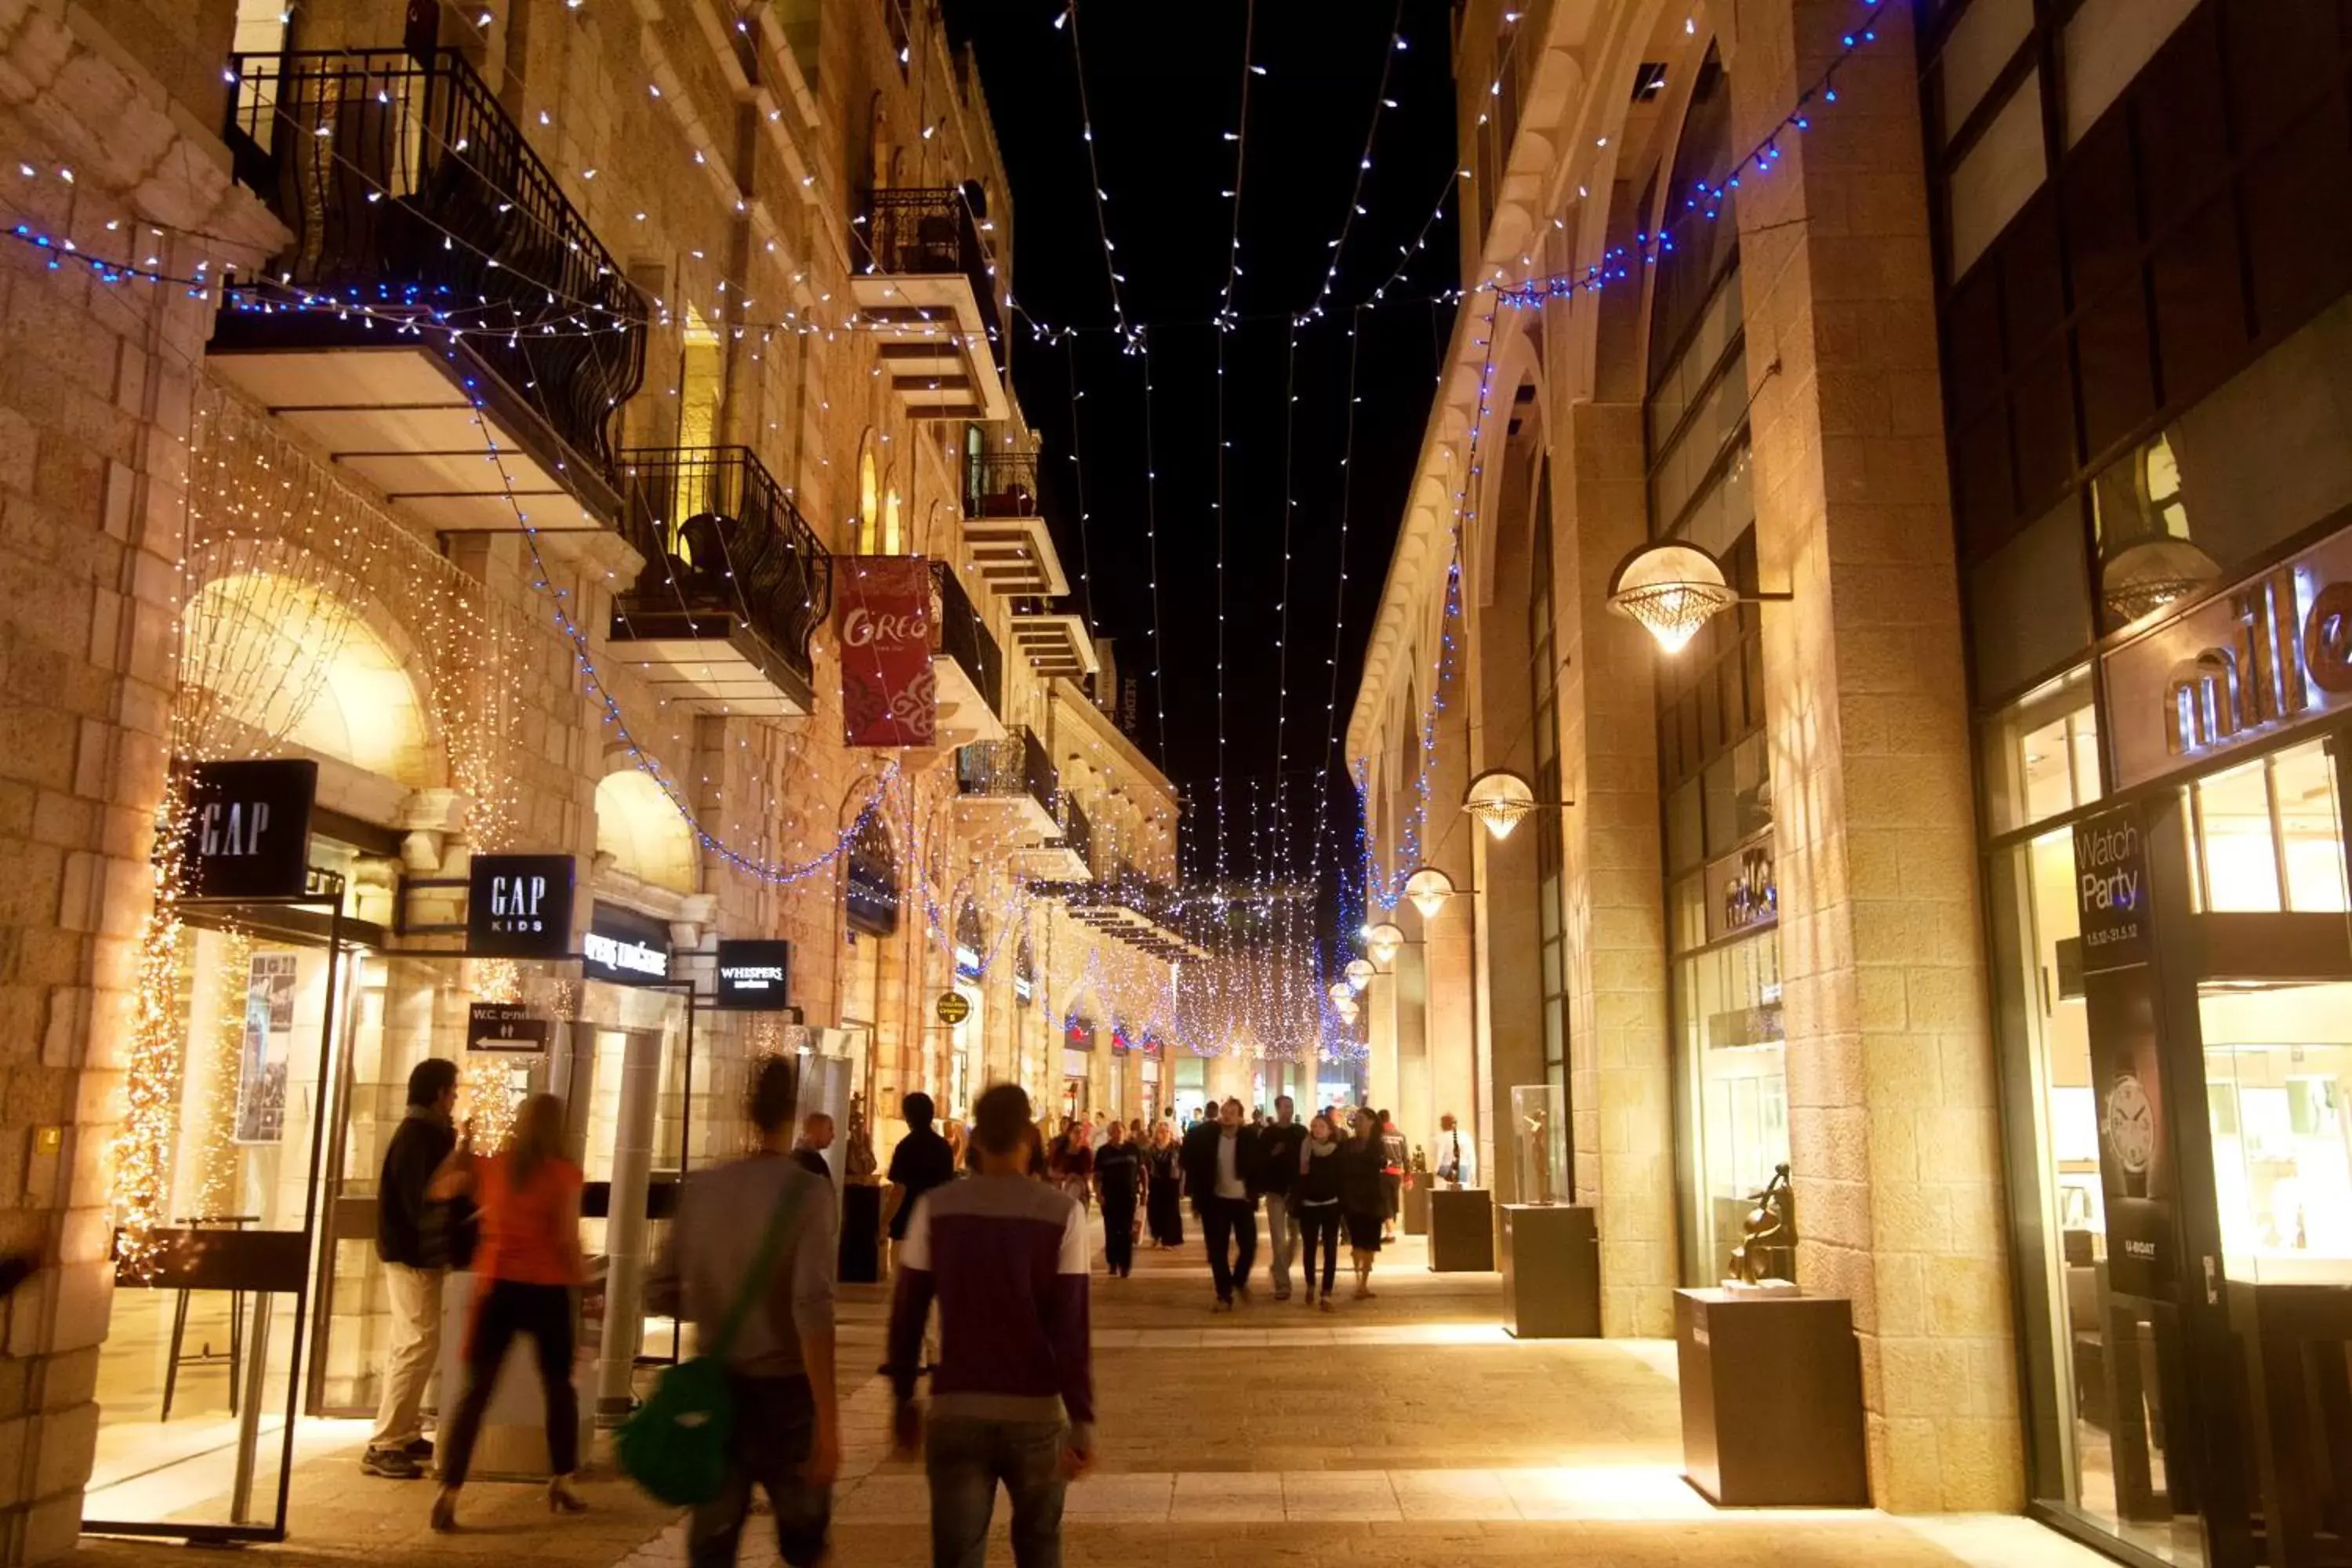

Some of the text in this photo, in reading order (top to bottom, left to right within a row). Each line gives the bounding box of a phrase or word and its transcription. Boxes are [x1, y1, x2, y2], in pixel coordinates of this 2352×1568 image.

[201, 802, 270, 855] GAP
[2075, 820, 2138, 869] Watch
[491, 877, 545, 916] GAP
[2082, 866, 2138, 913] Party
[492, 920, 543, 932] KIDS
[721, 967, 783, 981] WHISPERS
